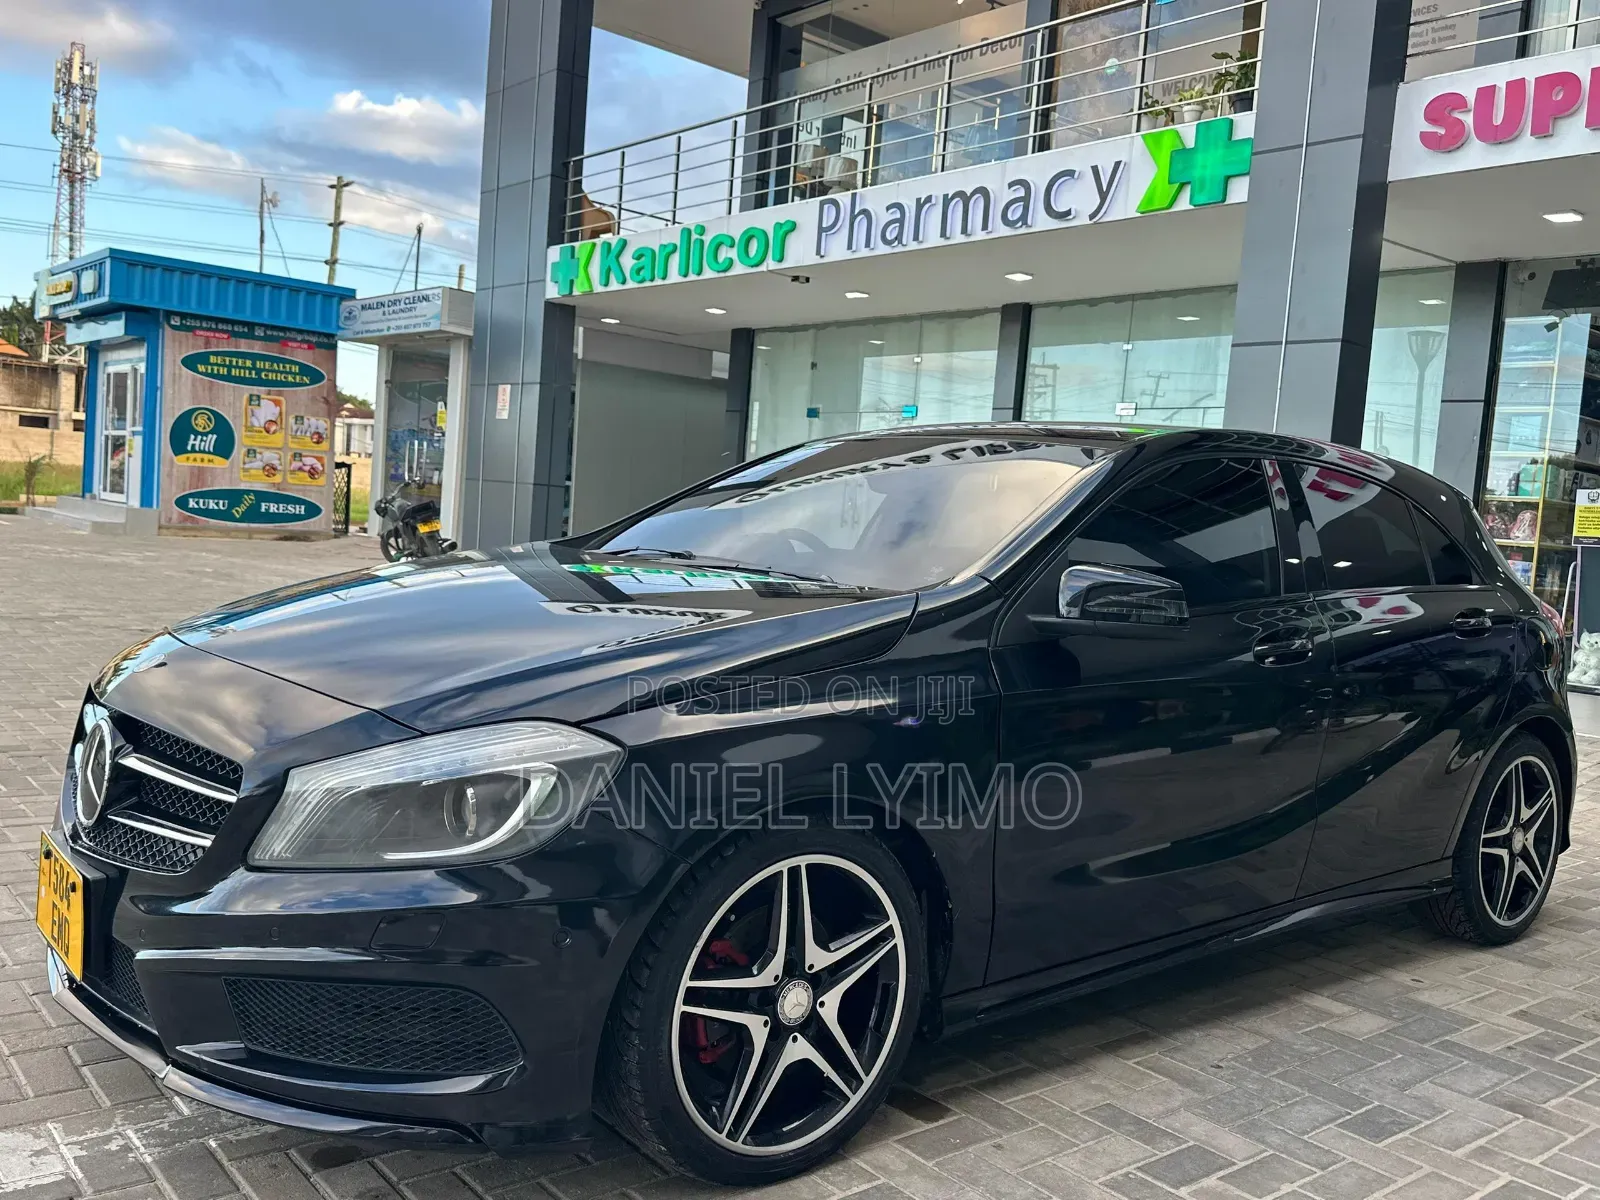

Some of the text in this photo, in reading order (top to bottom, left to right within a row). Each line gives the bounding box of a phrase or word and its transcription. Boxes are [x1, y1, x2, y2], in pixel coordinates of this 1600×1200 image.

[599, 159, 1127, 288] Karlicor Pharmacy
[360, 301, 386, 312] MALEN
[387, 298, 402, 308] DRY
[388, 305, 418, 316] LAUNDRY
[197, 364, 310, 384] WITH HILL CHICKEN
[209, 355, 299, 373] BETTER HEALTH
[186, 433, 217, 453] Hill
[188, 492, 306, 519] KUKU Daily FRESH
